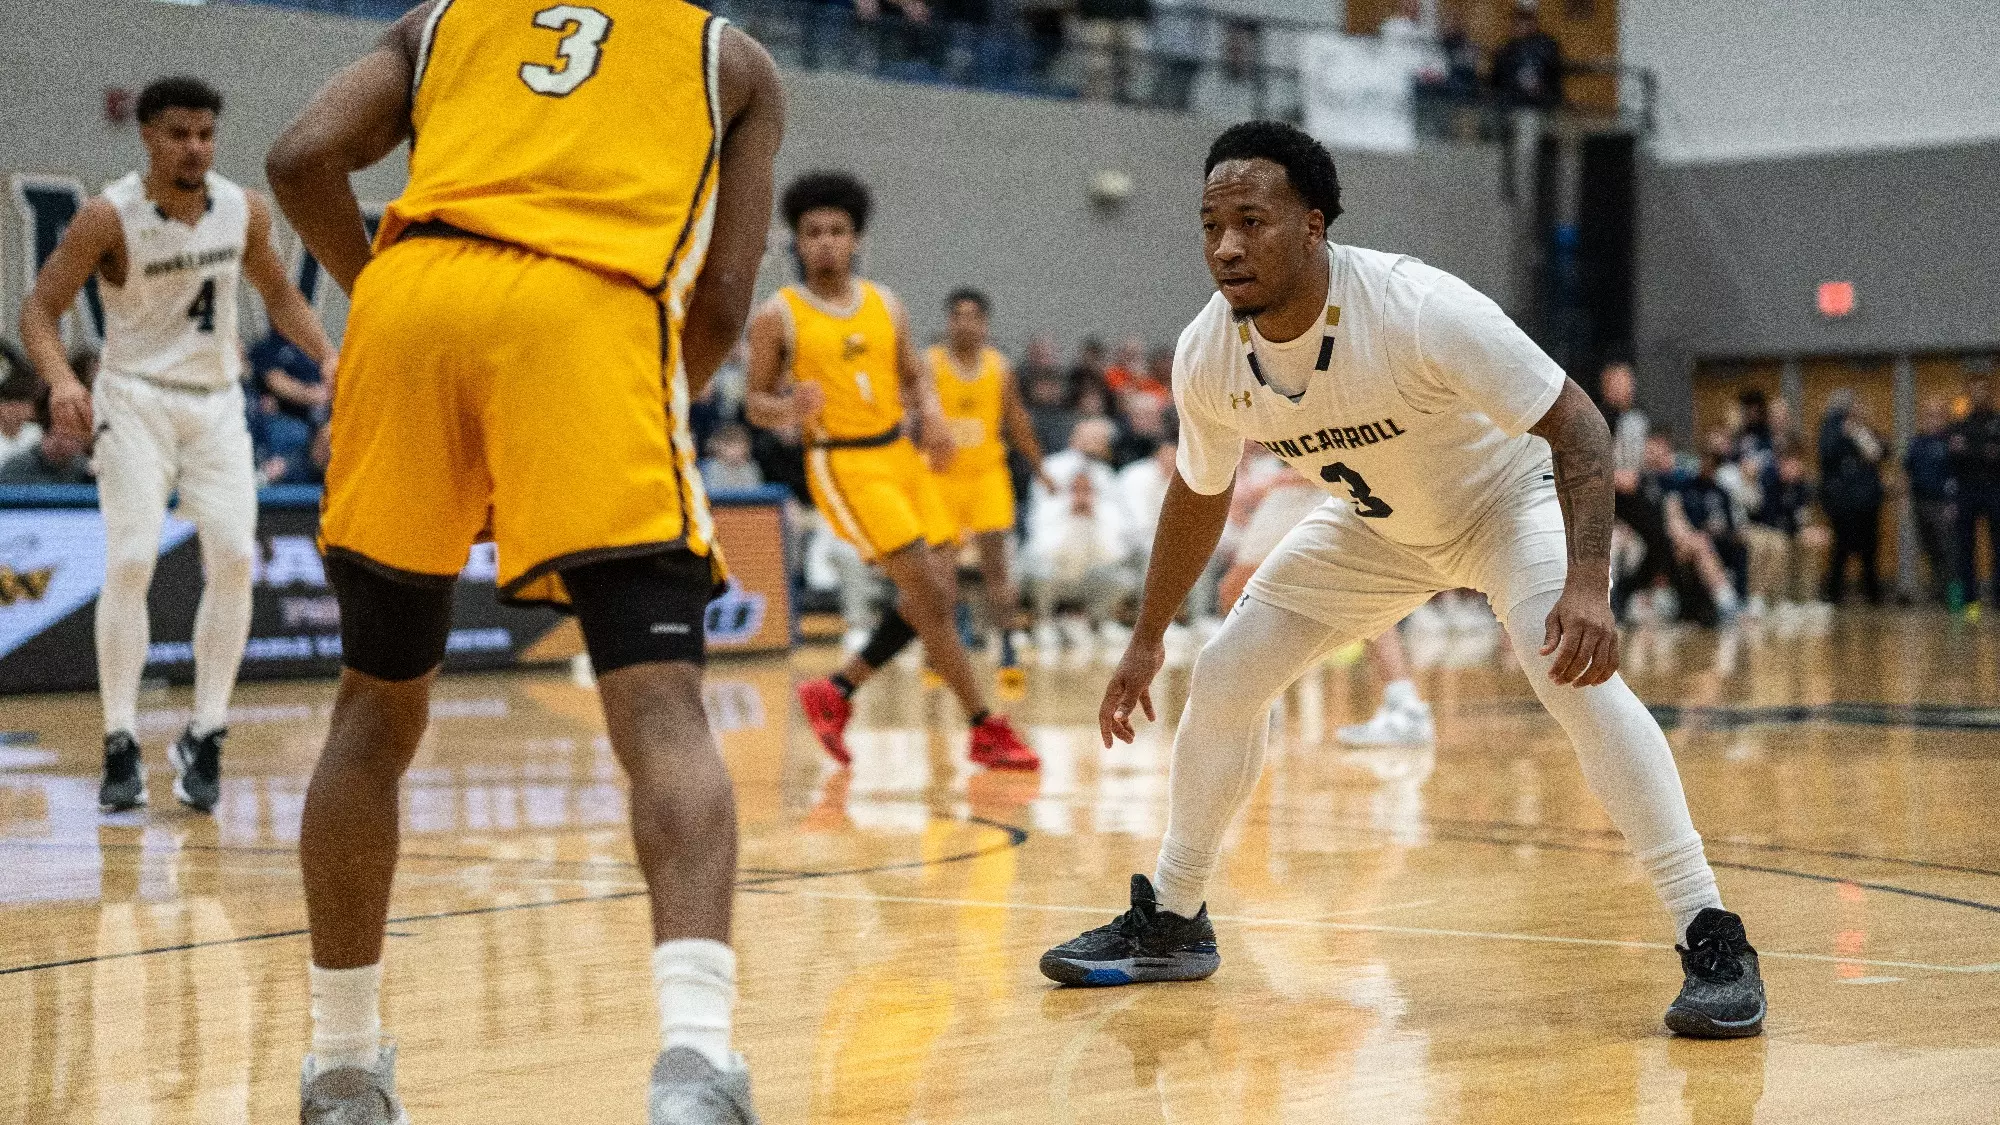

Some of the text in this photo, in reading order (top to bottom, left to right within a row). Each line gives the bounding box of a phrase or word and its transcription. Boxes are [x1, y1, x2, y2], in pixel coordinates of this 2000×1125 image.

[519, 4, 613, 97] 3
[188, 278, 216, 332] 4
[1298, 418, 1407, 454] CARROLL
[1320, 461, 1393, 517] 3
